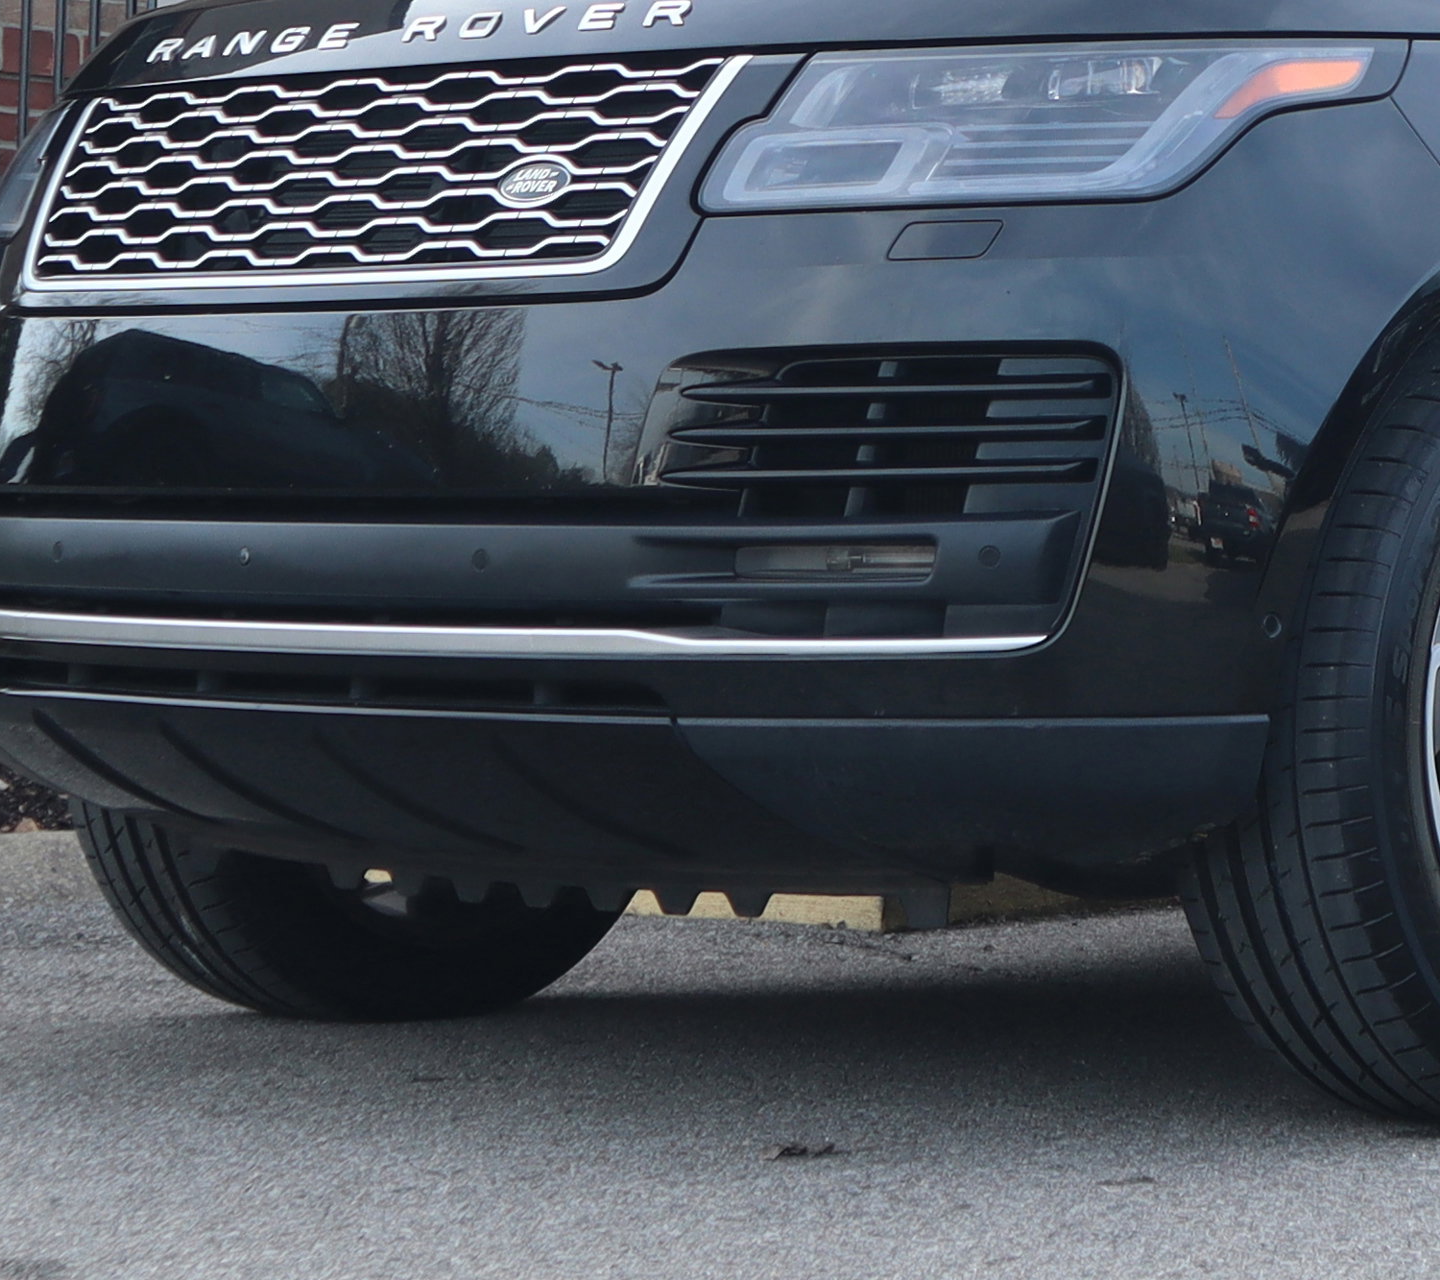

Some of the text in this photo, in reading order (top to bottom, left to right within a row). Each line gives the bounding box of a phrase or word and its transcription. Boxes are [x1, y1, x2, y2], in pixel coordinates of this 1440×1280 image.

[145, 21, 361, 65] RANGE
[512, 167, 552, 182] LAND
[510, 179, 558, 194] ROVER
